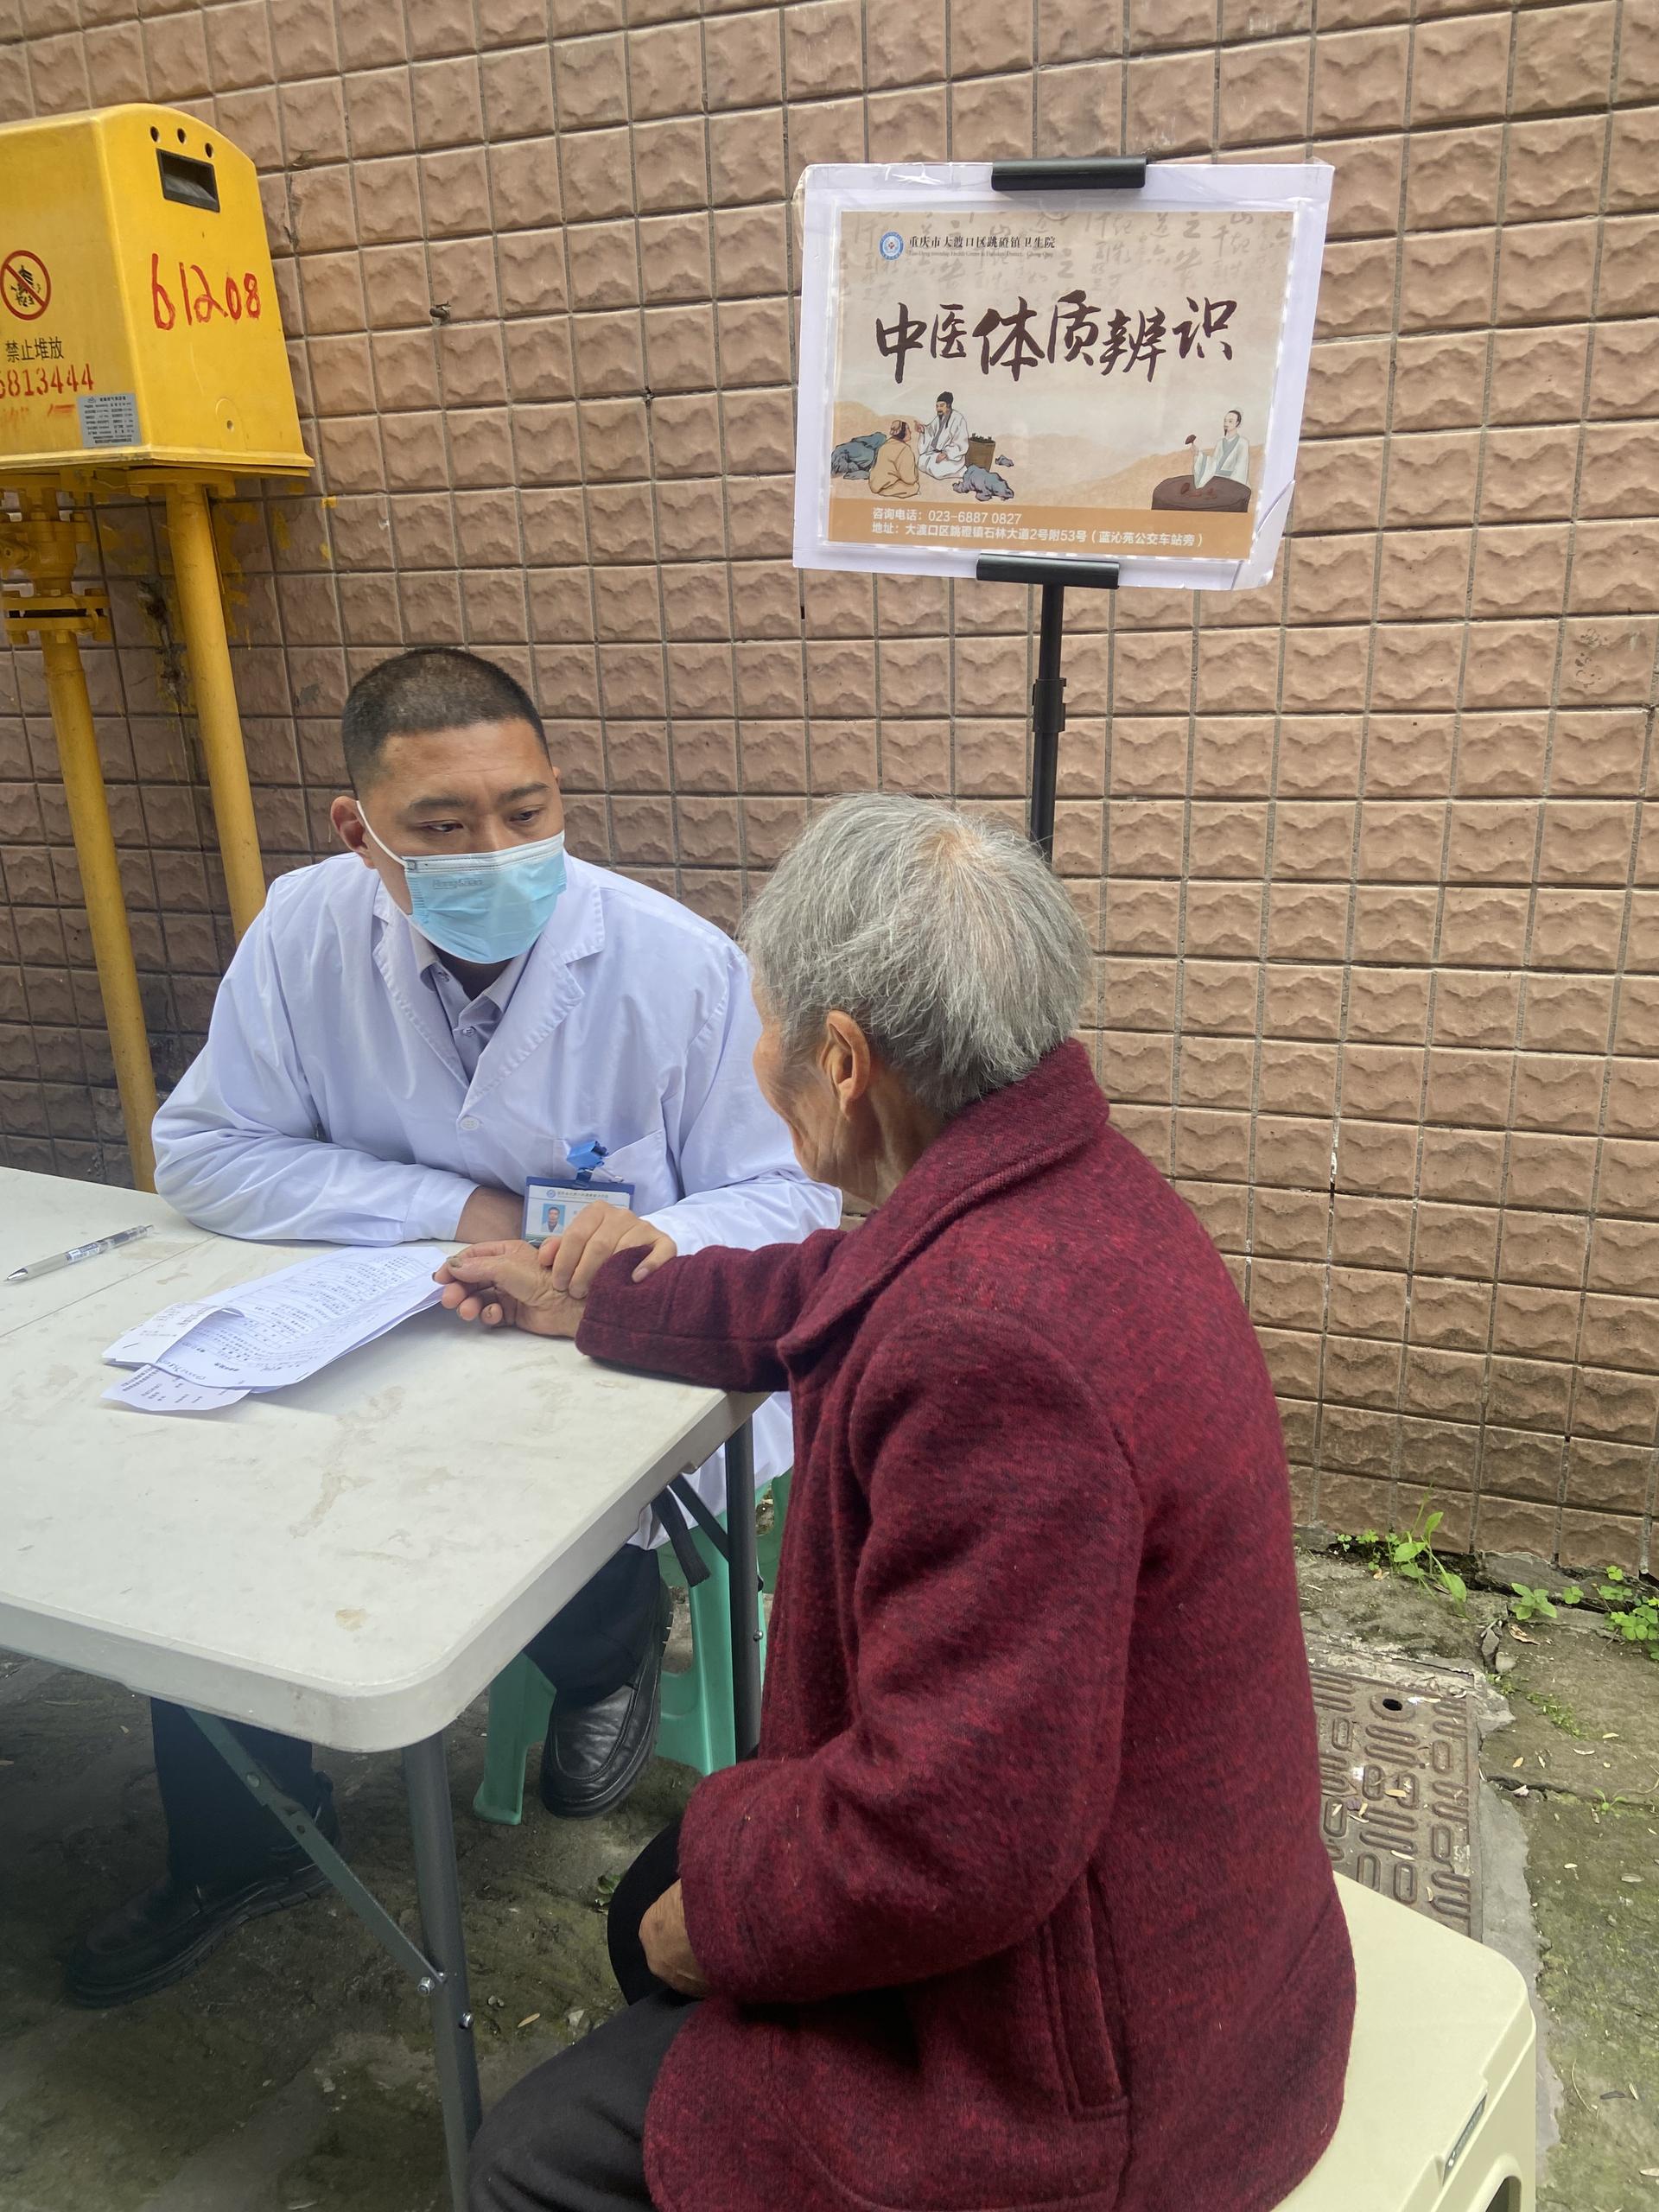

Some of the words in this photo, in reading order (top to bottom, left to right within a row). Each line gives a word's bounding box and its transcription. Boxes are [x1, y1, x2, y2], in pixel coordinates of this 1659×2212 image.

[909, 235, 1056, 249] 重庆市大渡口区跳磴镇卫生院
[152, 252, 261, 330] 61208
[5, 336, 64, 363] 禁止堆放
[875, 289, 1237, 384] 中医体质辨识
[992, 512, 1022, 524] 0827
